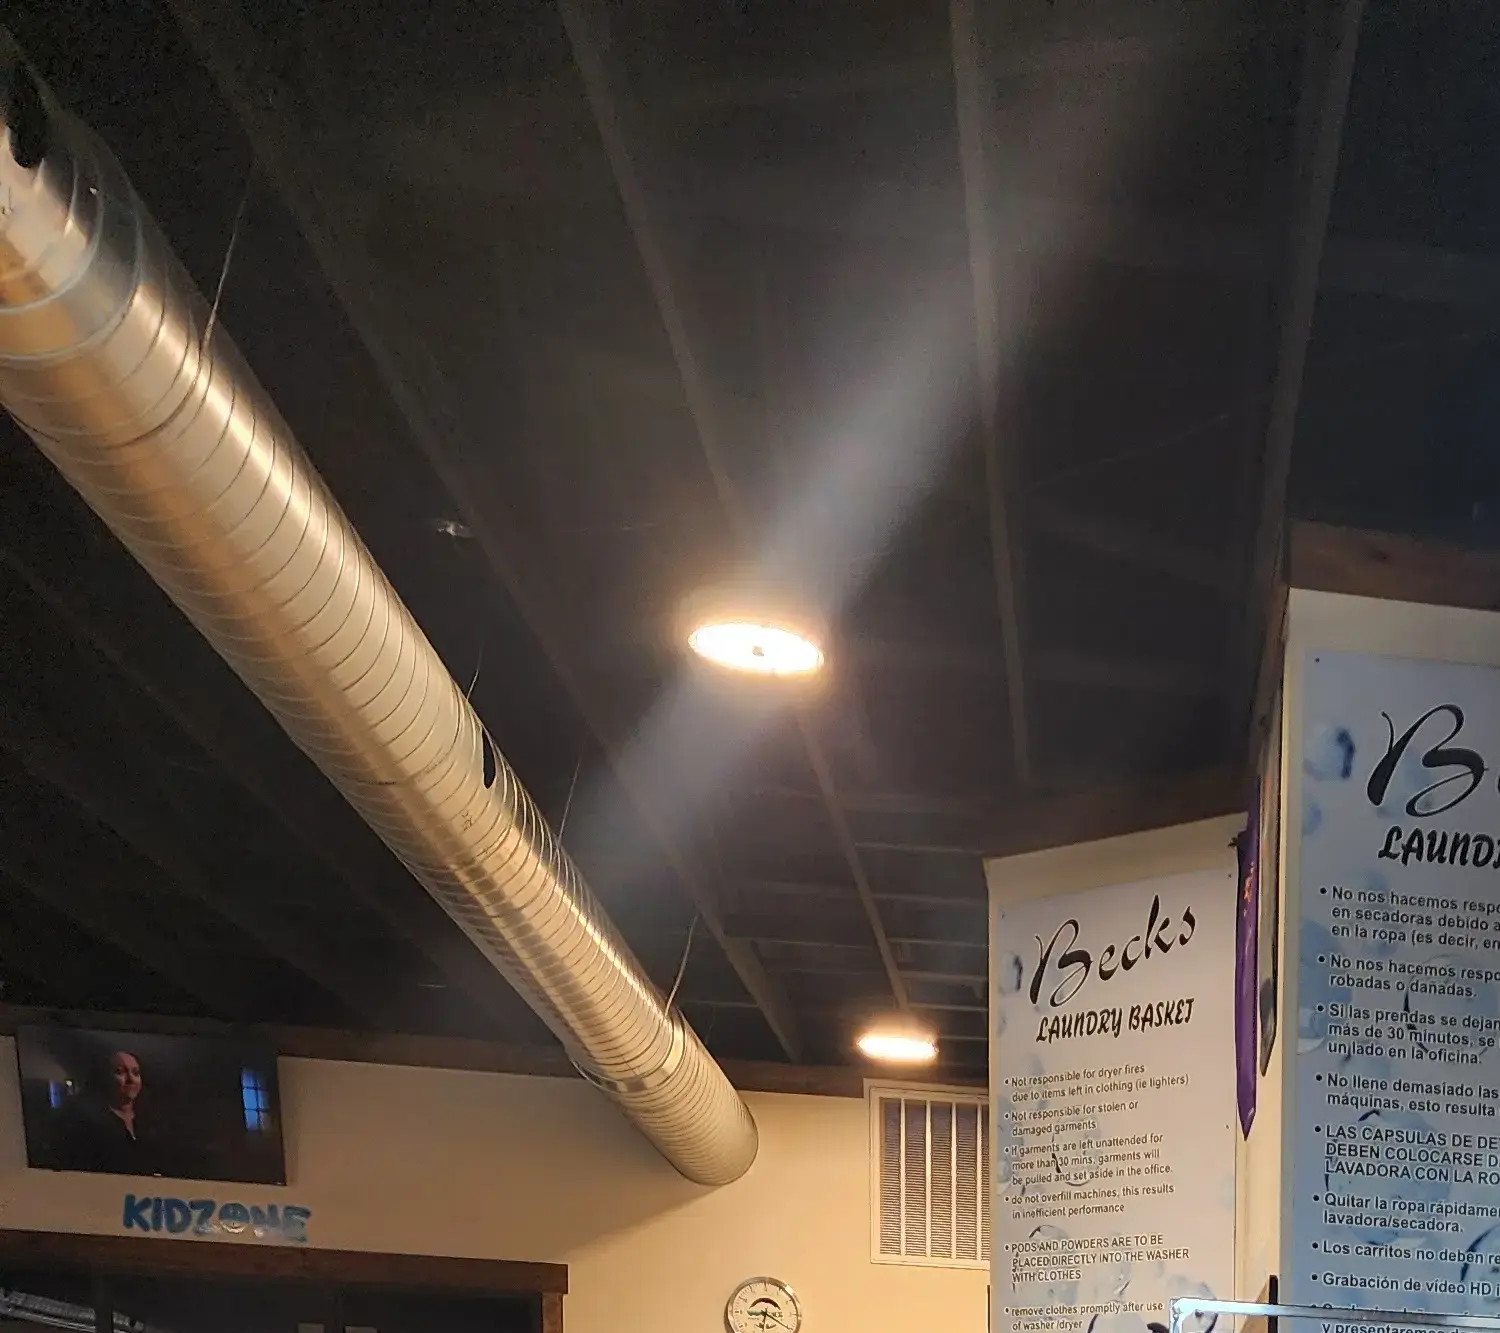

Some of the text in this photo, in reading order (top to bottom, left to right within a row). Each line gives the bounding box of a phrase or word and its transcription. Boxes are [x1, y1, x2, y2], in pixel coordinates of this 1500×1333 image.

[1332, 886, 1353, 900] No
[1357, 891, 1385, 903] nos
[1390, 890, 1458, 909] hacemos
[1332, 906, 1349, 918] en
[1354, 908, 1433, 925] secadoras
[1437, 912, 1489, 929] debido
[1492, 920, 1500, 930] a
[1332, 924, 1349, 936] en
[1355, 923, 1367, 937] la
[1372, 928, 1406, 943] ropa
[1411, 928, 1433, 944] (es
[1438, 930, 1477, 948] decir,
[1029, 894, 1196, 1007] Becks
[1331, 954, 1351, 969] No
[1355, 959, 1383, 971] nos
[1389, 959, 1455, 977] hacemos
[1330, 974, 1391, 990] robadas
[1395, 981, 1405, 991] o
[1036, 998, 1195, 1044] LAUNDRY BASKET
[1349, 1004, 1369, 1019] las
[1375, 1009, 1435, 1024] prendas
[1440, 1015, 1457, 1026] se
[1328, 1023, 1360, 1037] más
[1364, 1024, 1382, 1039] de
[1386, 1026, 1404, 1040] 30
[1409, 1029, 1473, 1048] minutos,
[1478, 1036, 1495, 1047] se
[1328, 1041, 1481, 1064] un lado en la oficina.
[1011, 1065, 1145, 1086] Not responsible for dryer fires
[1327, 1073, 1499, 1098] No llene demasiado las
[1012, 1093, 1029, 1102] due
[1031, 1092, 1039, 1100] to
[1041, 1089, 1065, 1099] items
[1068, 1086, 1082, 1097] left
[1084, 1085, 1094, 1095] in
[1095, 1082, 1133, 1094] clothing
[1327, 1092, 1404, 1111] máquinas,
[1408, 1099, 1440, 1112] esto
[1445, 1102, 1495, 1116] resulta
[1012, 1120, 1096, 1136] damaged garments
[1326, 1125, 1356, 1140] LAS
[1361, 1127, 1446, 1146] CAPSULAS
[1451, 1134, 1472, 1148] DE
[1326, 1143, 1380, 1159] DEBEN
[1384, 1147, 1482, 1166] COLOCARSE
[1325, 1161, 1410, 1179] LAVADORA
[1415, 1167, 1448, 1181] CON
[1453, 1169, 1473, 1183] LA
[1324, 1192, 1370, 1208] Quitar
[1375, 1196, 1386, 1209] la
[1392, 1200, 1425, 1214] ropa
[1324, 1211, 1463, 1232] lavadora/secadora.
[1011, 1234, 1163, 1252] PODS AND POWDERS ARE TO BE
[1323, 1241, 1349, 1255] Los
[1355, 1244, 1411, 1259] carritos
[1416, 1249, 1434, 1260] no
[1438, 1248, 1483, 1264] deben
[1012, 1249, 1189, 1267] PLACED DIRECTLY INTO THE WASHER
[1012, 1269, 1081, 1282] WITH CLOTHES
[1322, 1272, 1398, 1290] Grabación
[1403, 1277, 1420, 1291] de
[1470, 1281, 1491, 1295] HD
